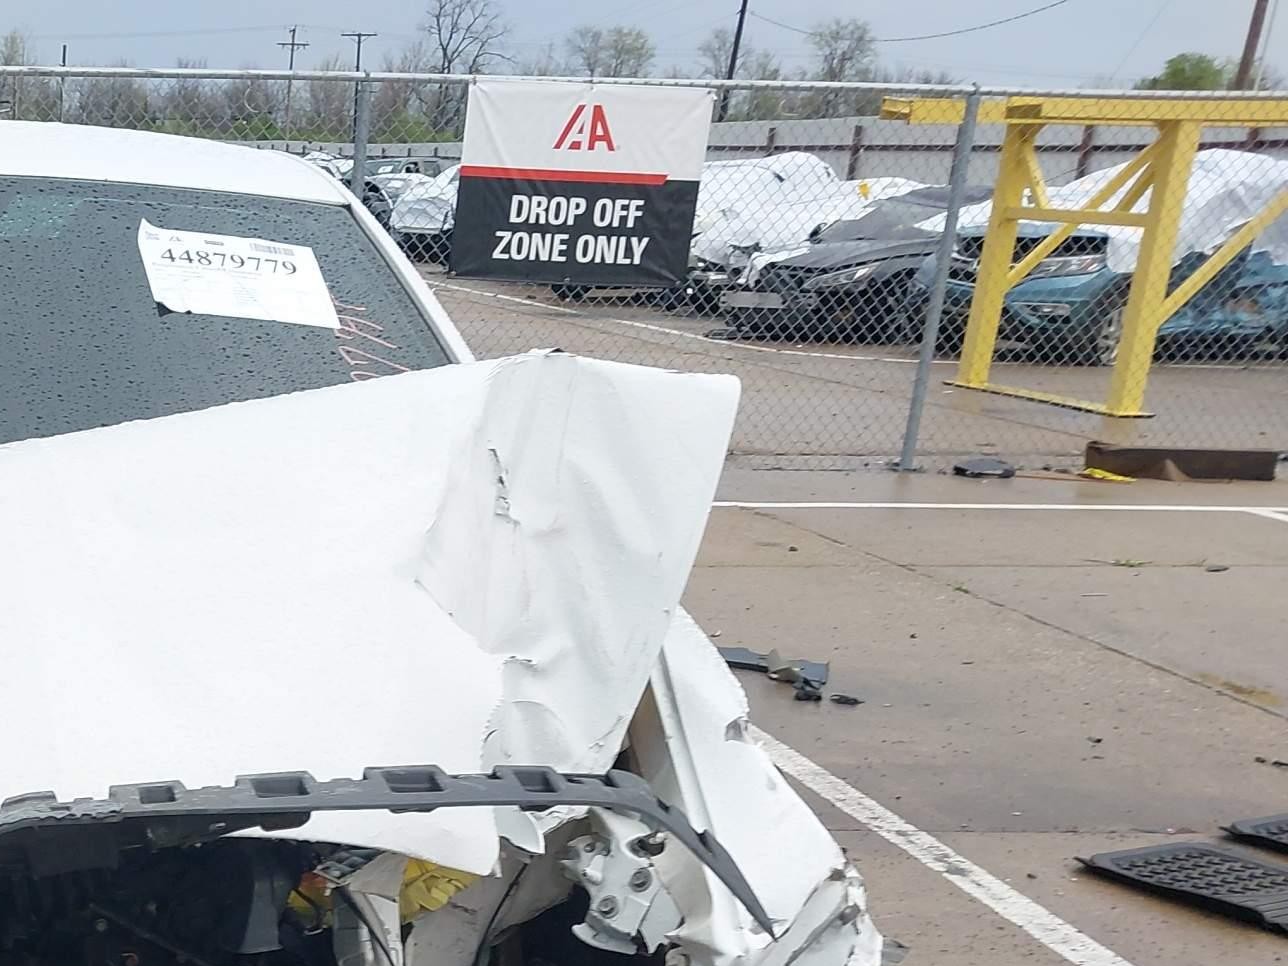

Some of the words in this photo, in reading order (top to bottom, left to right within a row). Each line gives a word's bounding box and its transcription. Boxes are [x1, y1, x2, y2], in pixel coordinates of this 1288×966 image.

[509, 195, 587, 226] DROP
[593, 199, 645, 228] OFF
[160, 247, 297, 275] 44879779
[492, 231, 570, 262] ZONE
[575, 235, 650, 265] ONLY
